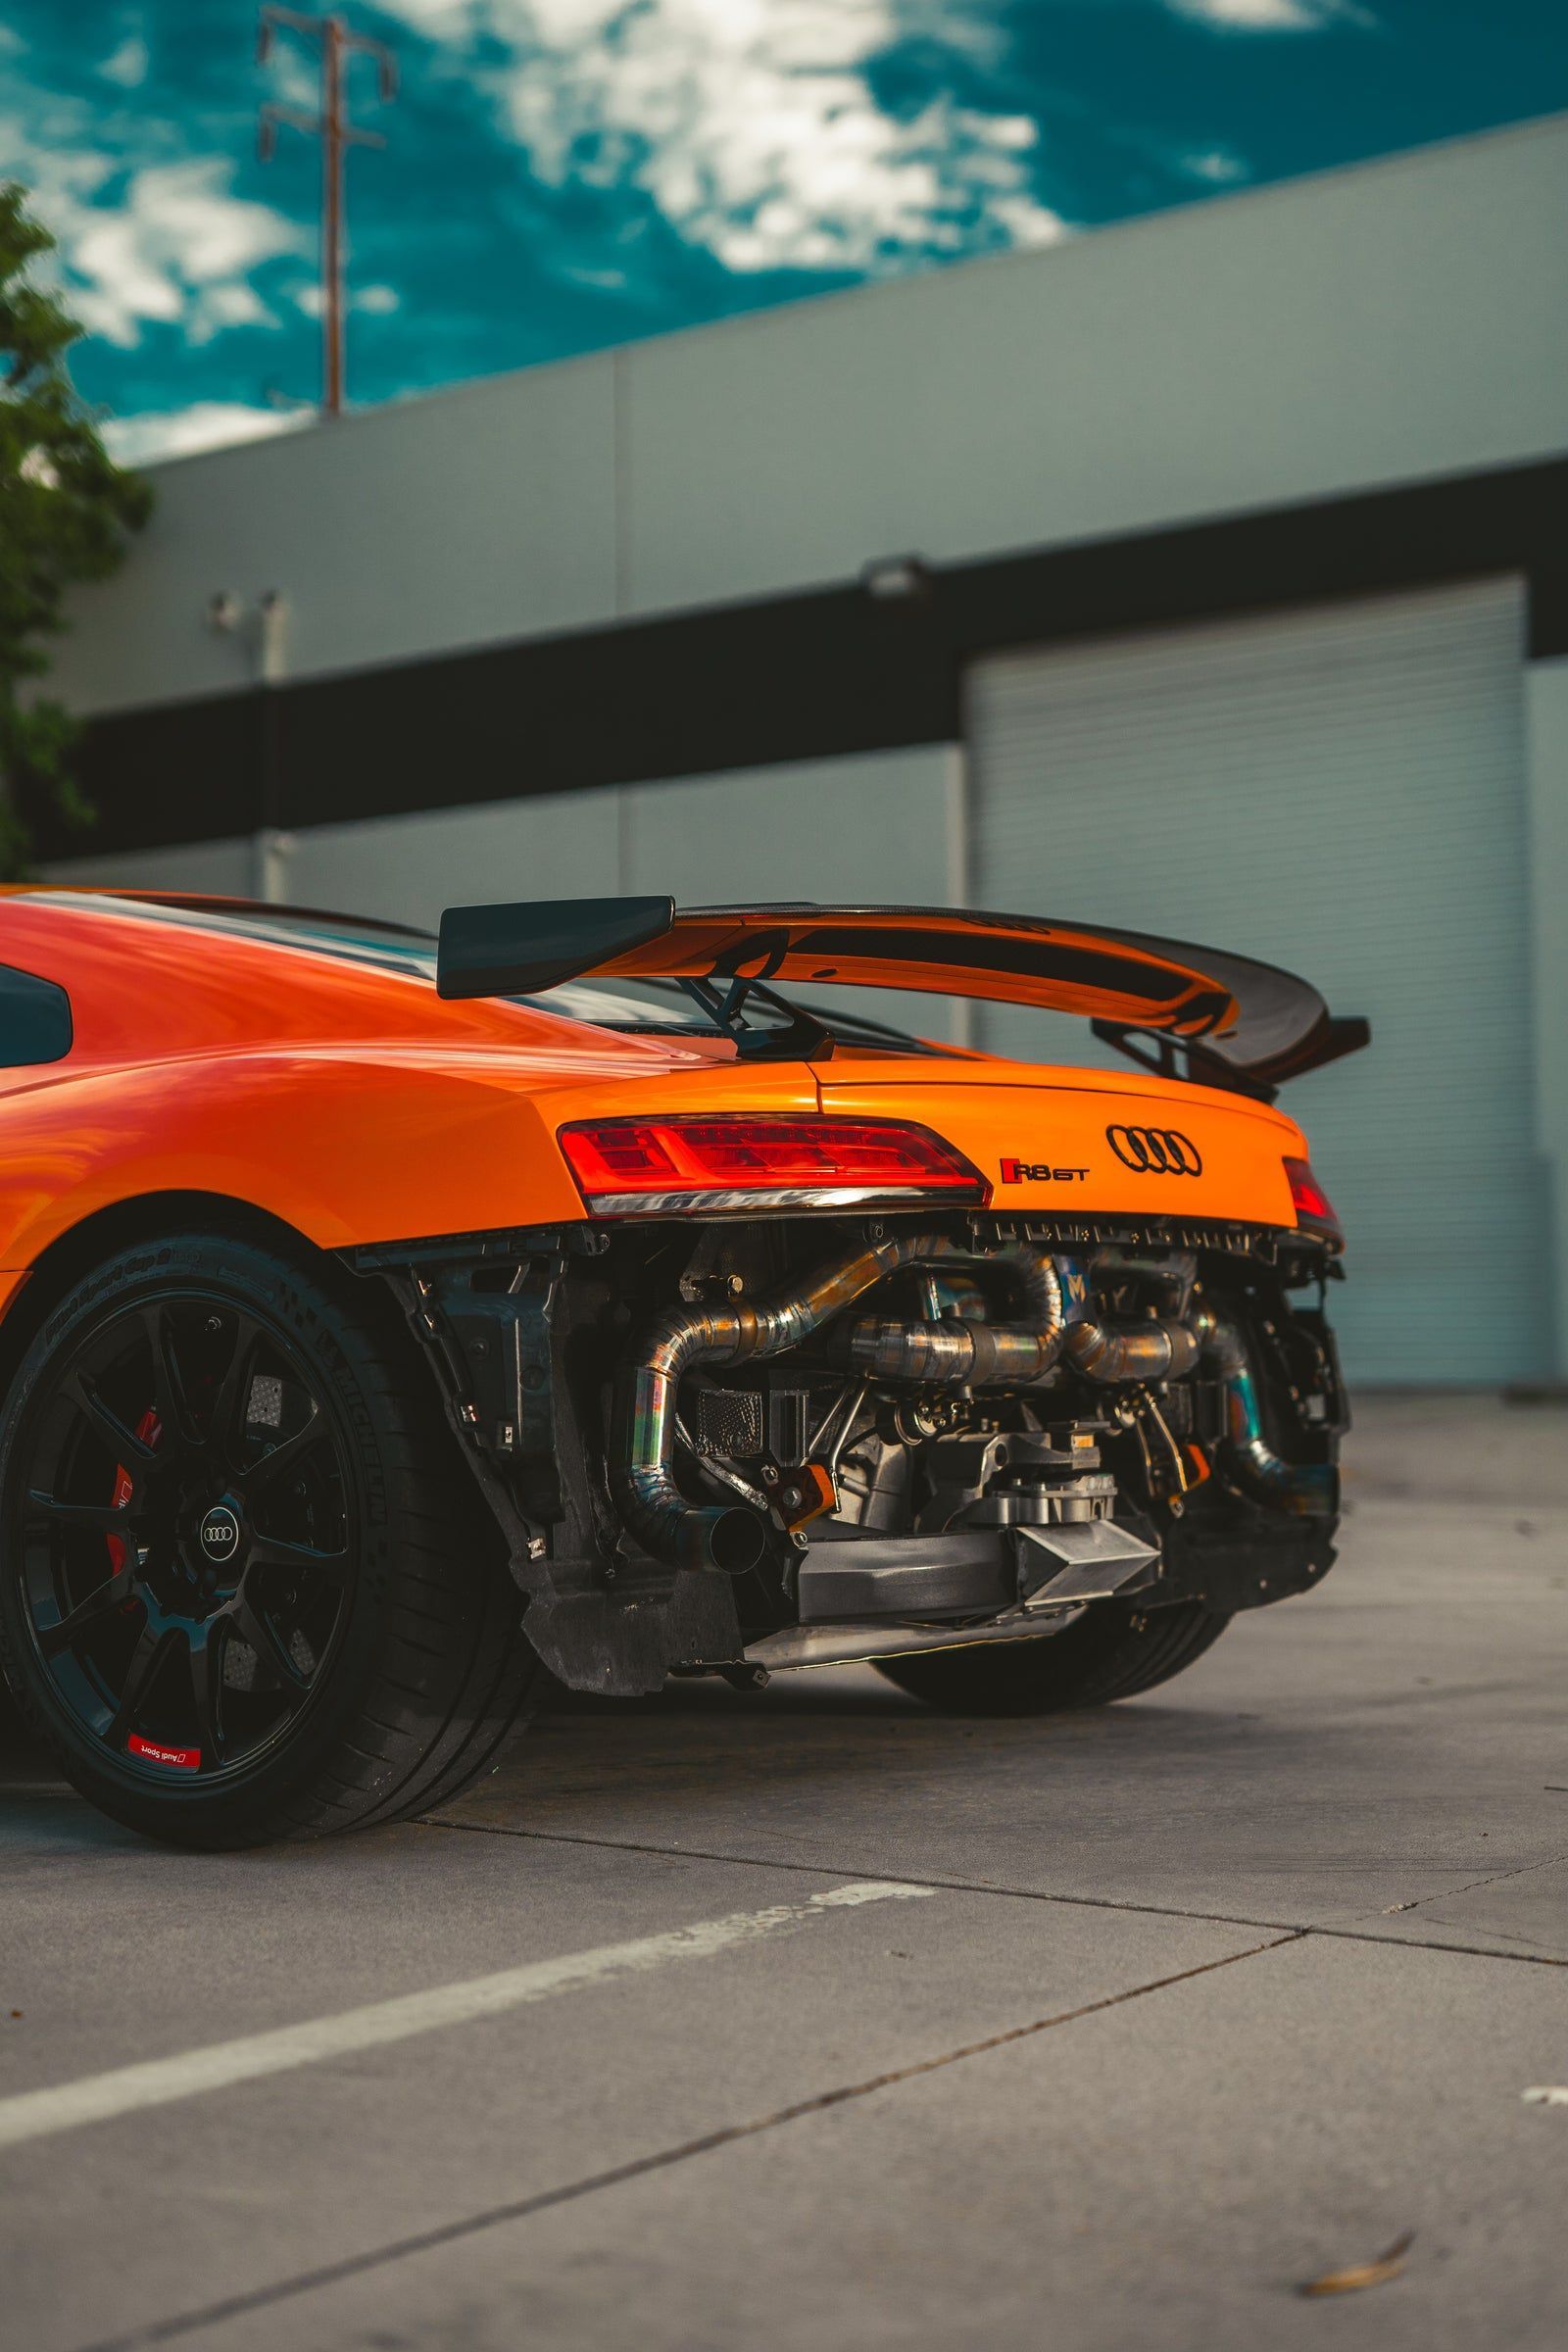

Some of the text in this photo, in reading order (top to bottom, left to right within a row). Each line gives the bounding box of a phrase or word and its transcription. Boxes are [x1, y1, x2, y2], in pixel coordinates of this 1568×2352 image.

[123, 1255, 156, 1275] Cup
[157, 1248, 172, 1266] 2
[334, 1363, 387, 1525] MICHELIN
[140, 1744, 178, 1762] Audi Sport
